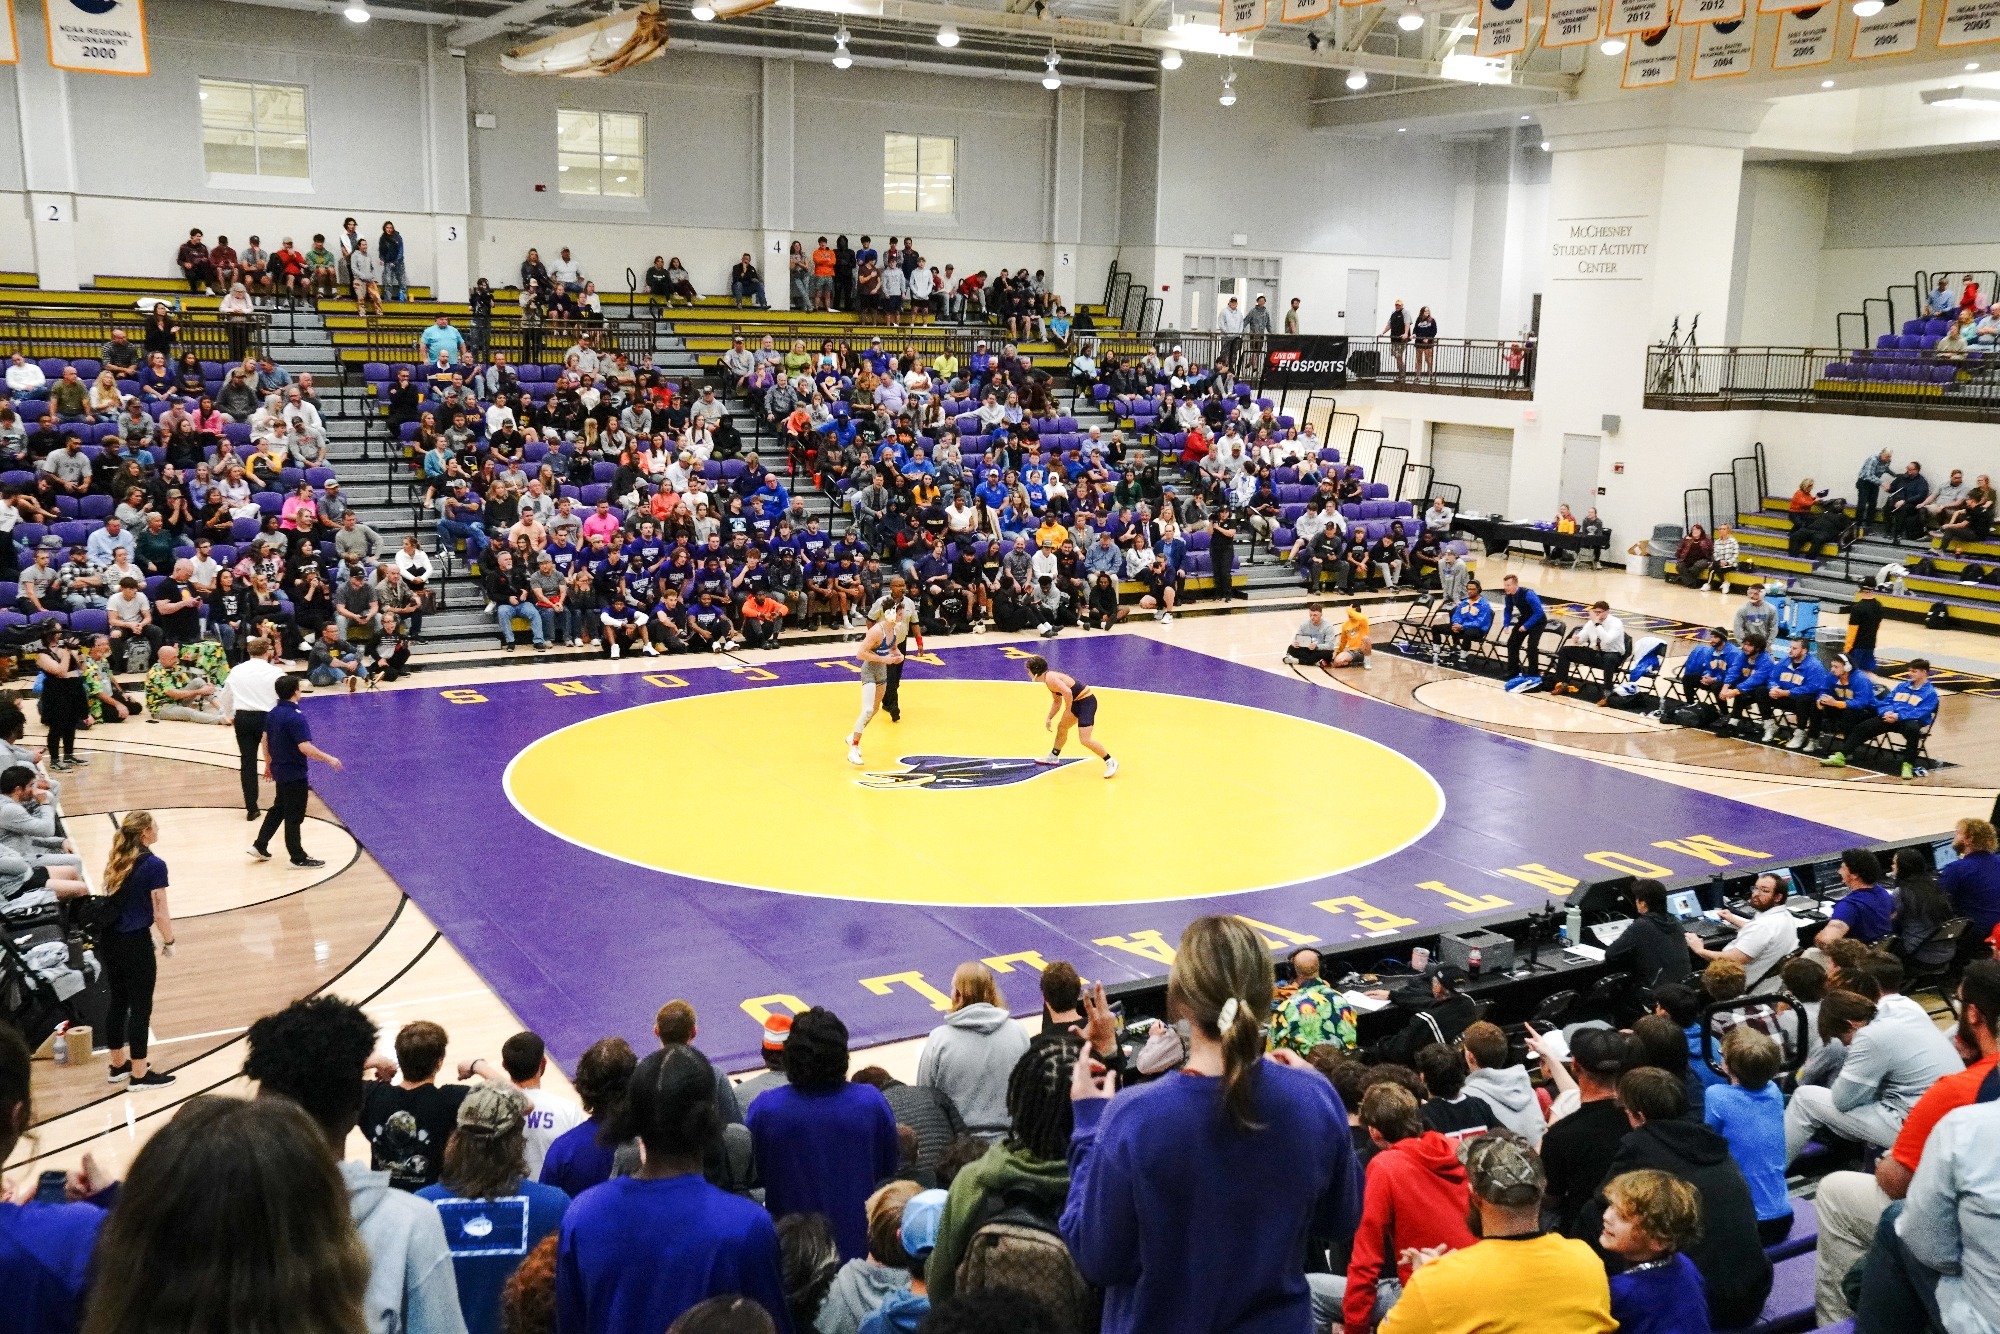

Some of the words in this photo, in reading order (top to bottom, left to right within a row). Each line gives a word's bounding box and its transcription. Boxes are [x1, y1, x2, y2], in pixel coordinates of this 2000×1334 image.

[1626, 10, 1651, 23] 2012
[59, 24, 84, 34] NCAA
[87, 27, 133, 38] REGIONAL
[1562, 23, 1582, 35] 2011
[66, 34, 128, 46] TOURNAMENT
[1493, 34, 1511, 46] 2010
[82, 46, 117, 59] 2000
[48, 205, 60, 221] 2
[448, 226, 457, 241] 3
[773, 240, 782, 254] 4
[1552, 243, 1598, 257] STUDENT
[1599, 242, 1649, 256] ACTIVITY
[1062, 253, 1070, 266] 5
[1578, 261, 1617, 273] CENTER
[1274, 352, 1287, 360] LIVE
[1287, 352, 1297, 360] ON
